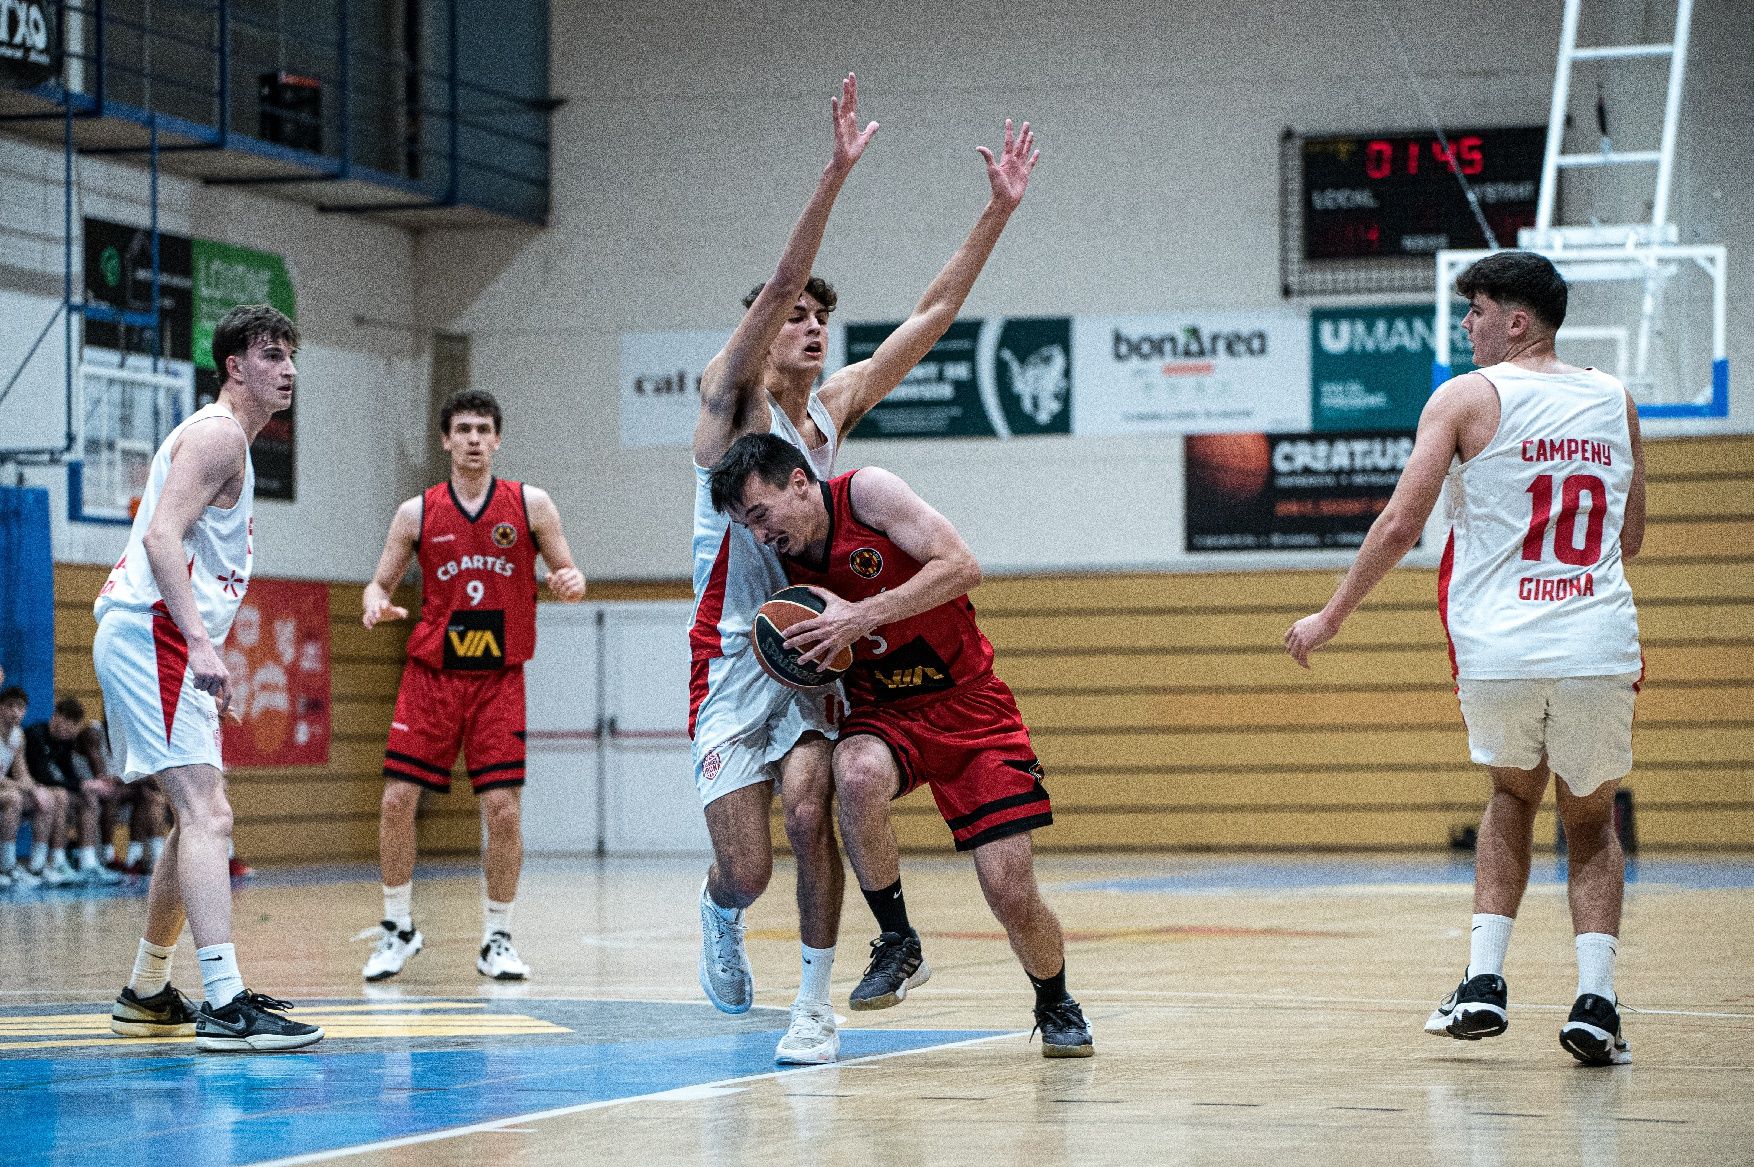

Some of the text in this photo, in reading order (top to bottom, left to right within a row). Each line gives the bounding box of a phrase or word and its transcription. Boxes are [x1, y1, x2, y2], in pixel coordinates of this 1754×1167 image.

[1521, 438, 1613, 466] CAMPENY
[1522, 474, 1608, 566] 10
[437, 555, 515, 581] CB ARTÉS
[466, 580, 484, 606] 9
[1519, 573, 1594, 601] GIRONA
[448, 630, 502, 657] VIA
